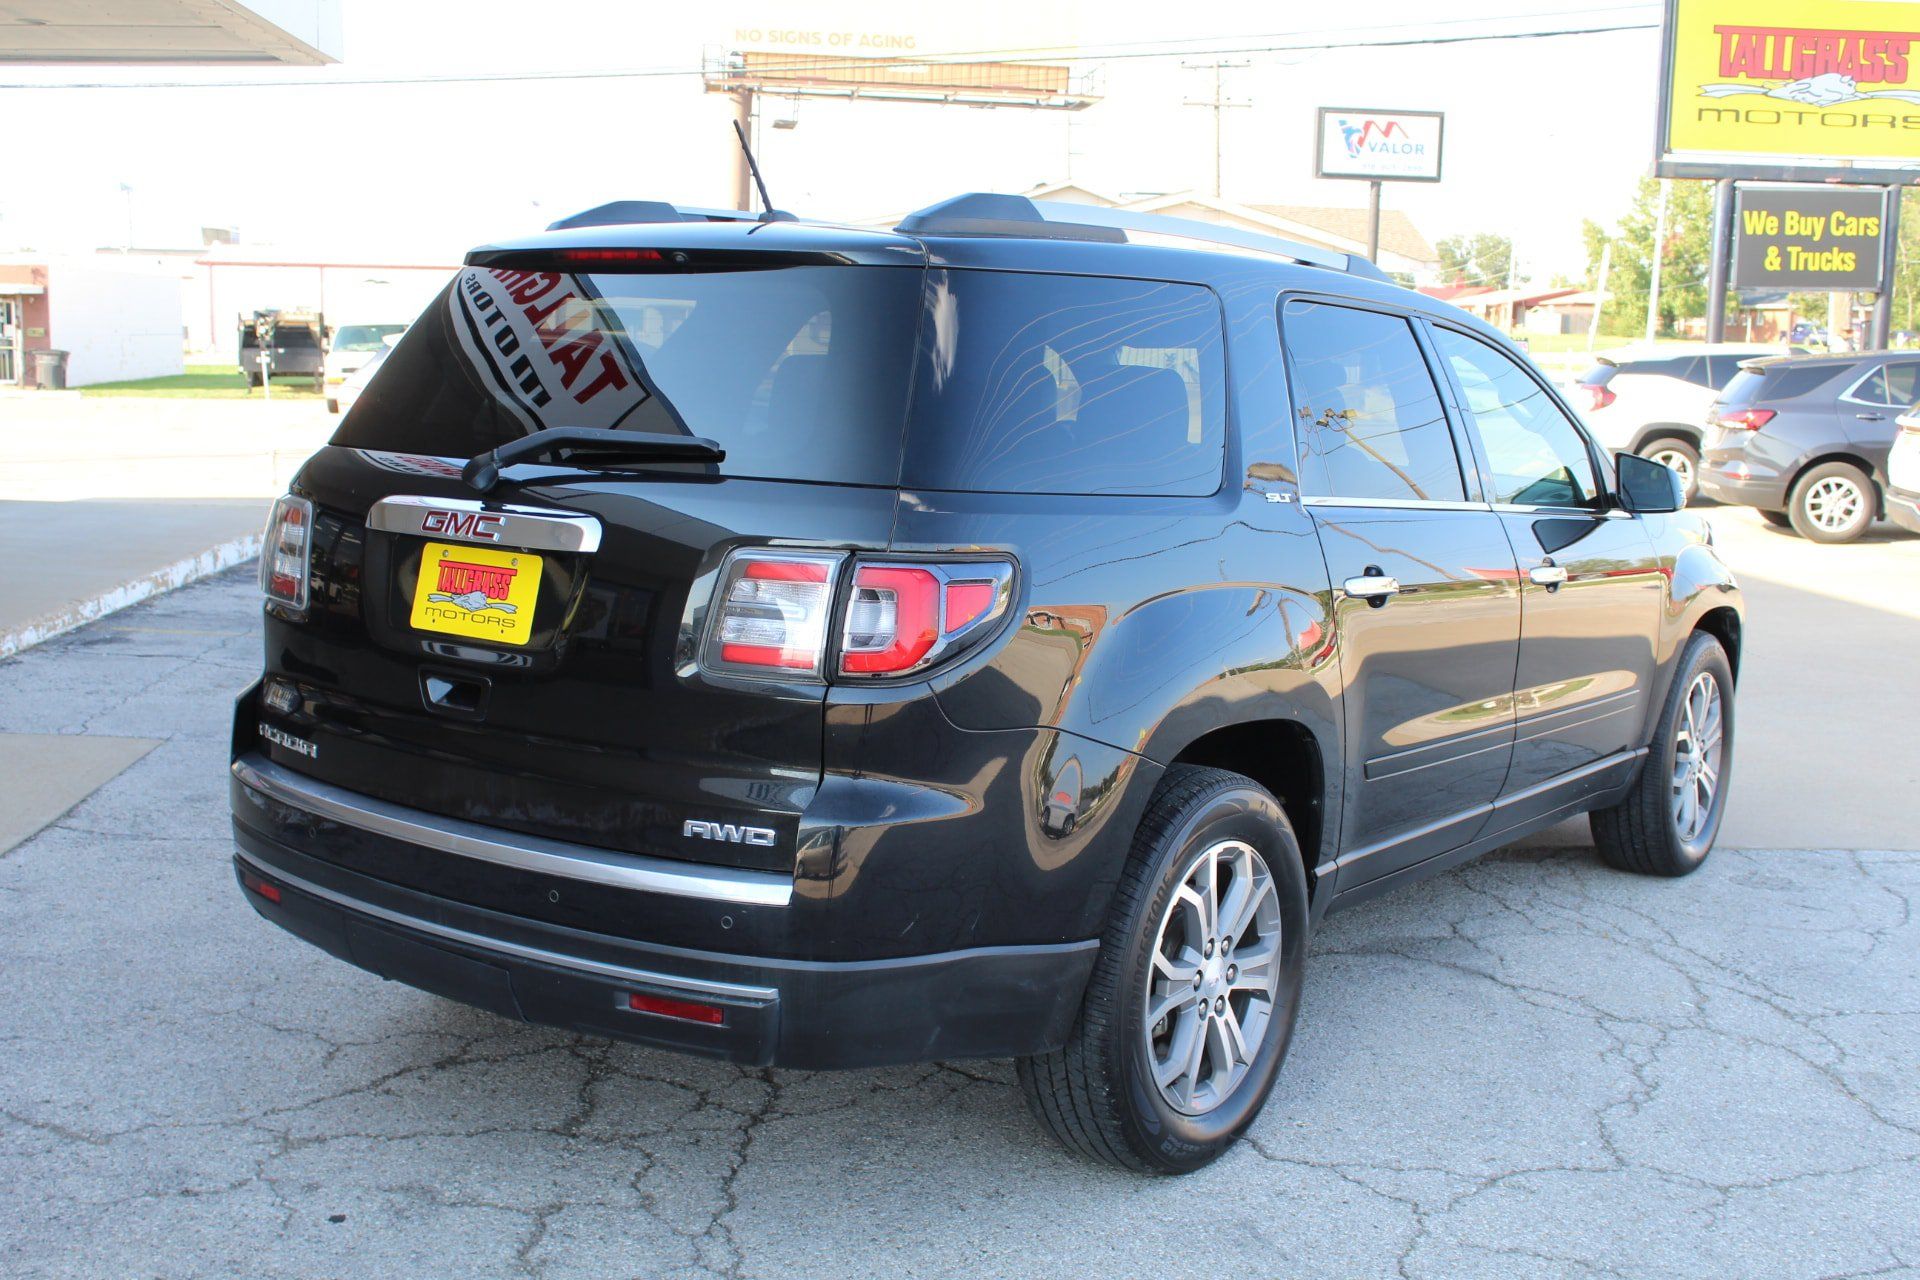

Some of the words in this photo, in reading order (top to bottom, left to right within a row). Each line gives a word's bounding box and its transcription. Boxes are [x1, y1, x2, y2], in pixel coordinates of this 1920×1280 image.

[735, 28, 762, 43] NO
[768, 29, 822, 46] SIGNS
[828, 32, 853, 47] OF
[859, 32, 917, 49] AGING
[1713, 25, 1920, 84] TALLGRASS
[1368, 141, 1424, 155] VALOR
[1743, 210, 1779, 235] We
[1785, 211, 1825, 241] Buy
[1830, 211, 1880, 237] Cars
[1764, 245, 1781, 271] &
[1787, 246, 1856, 272] Trucks
[421, 510, 506, 542] GMC
[436, 559, 518, 600] TALLGRASS
[424, 607, 516, 629] MOTORS
[683, 819, 776, 847] AWD
